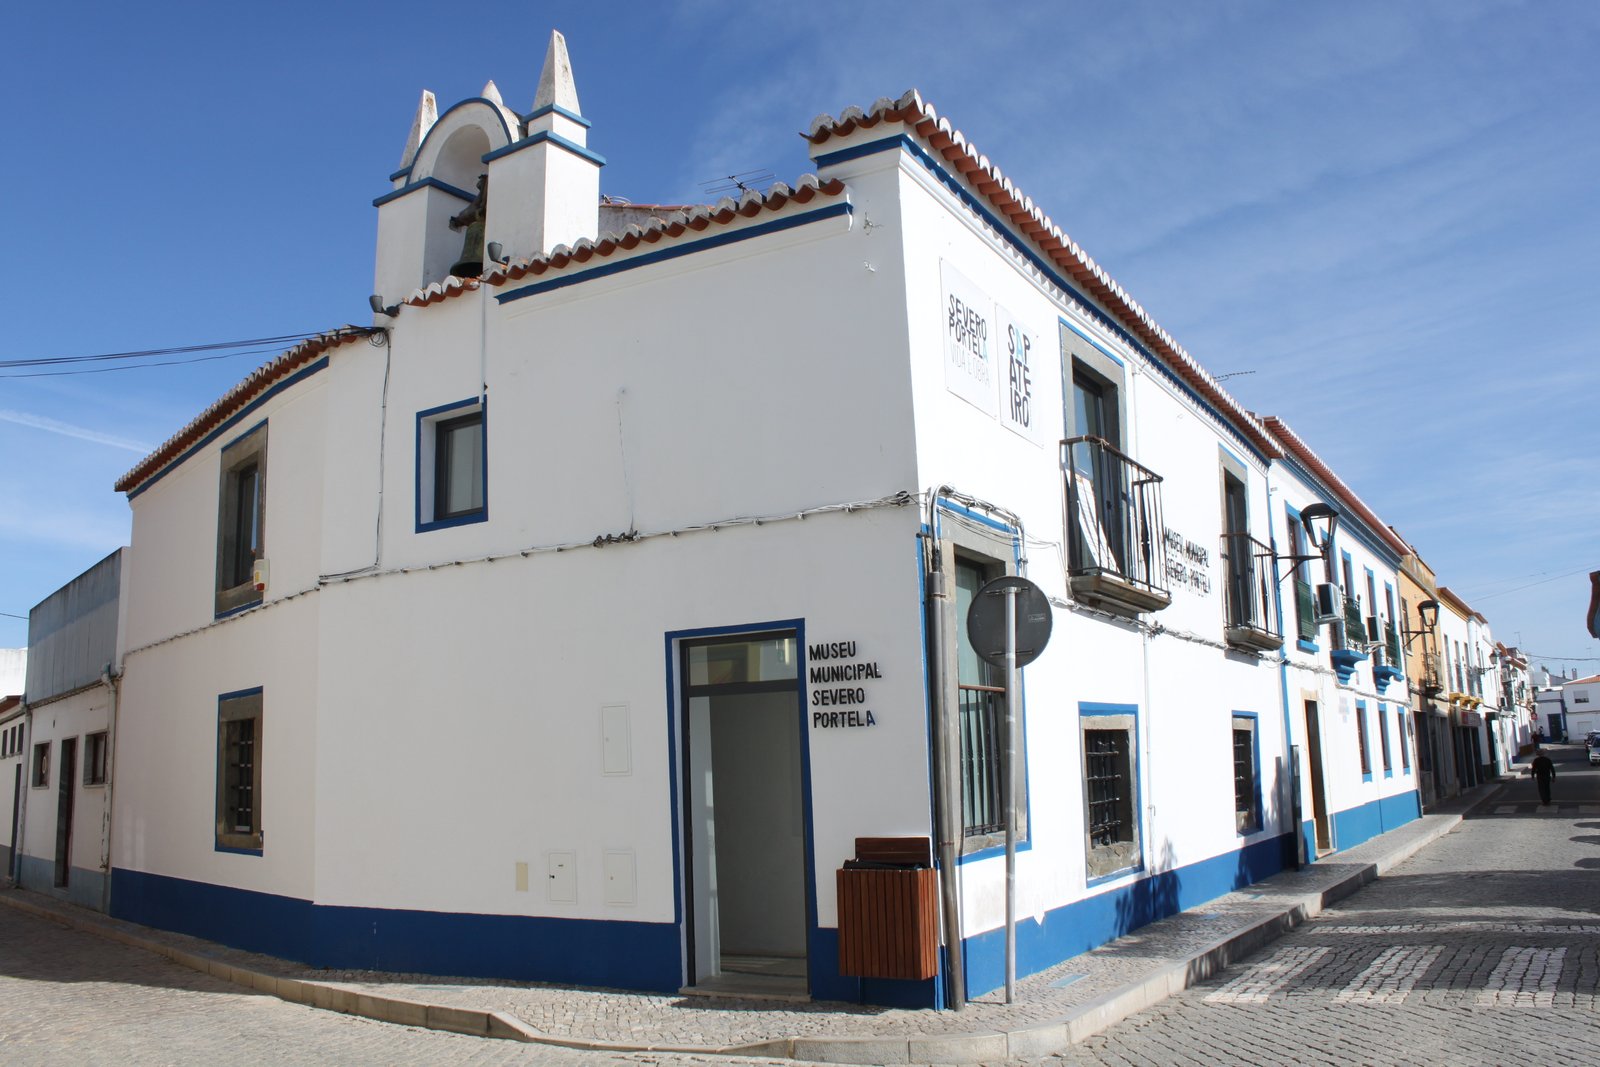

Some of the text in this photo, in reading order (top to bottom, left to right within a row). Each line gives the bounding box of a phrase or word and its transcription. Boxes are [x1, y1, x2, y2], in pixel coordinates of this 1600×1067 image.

[948, 294, 987, 342] SEVERO
[949, 316, 989, 364] PORTELA
[1008, 324, 1031, 364] SAP
[1010, 355, 1031, 398] ATE
[1010, 387, 1030, 428] IRO
[809, 641, 856, 661] MUSEU
[810, 662, 882, 684] MUNICIPAL
[812, 688, 865, 706] SEVERO
[813, 710, 876, 728] PORTELA
